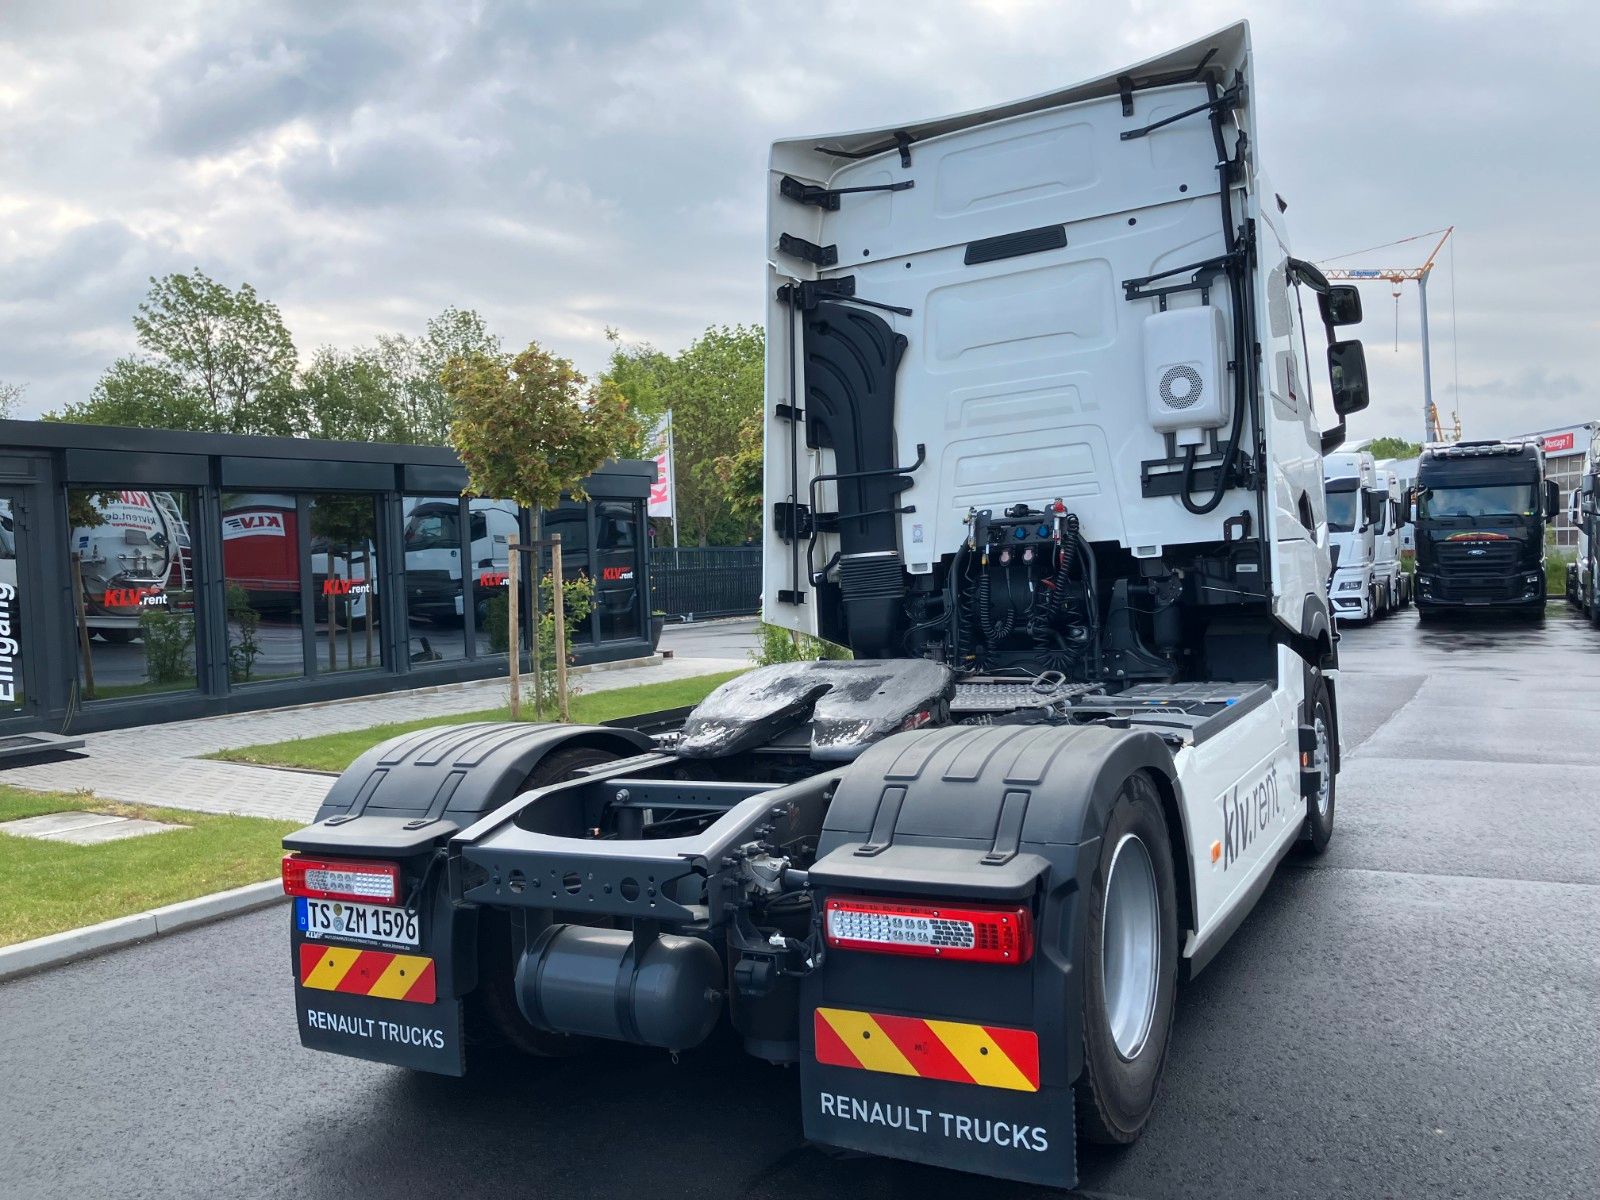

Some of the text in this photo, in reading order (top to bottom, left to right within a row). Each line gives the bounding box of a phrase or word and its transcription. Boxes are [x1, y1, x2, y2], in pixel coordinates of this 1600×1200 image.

[104, 588, 168, 608] KLV.rent
[308, 902, 416, 940] TS ZM 1596
[307, 1009, 445, 1049] RENAULT TRUCKS
[820, 1092, 1048, 1152] RENAULT TRUCKS
